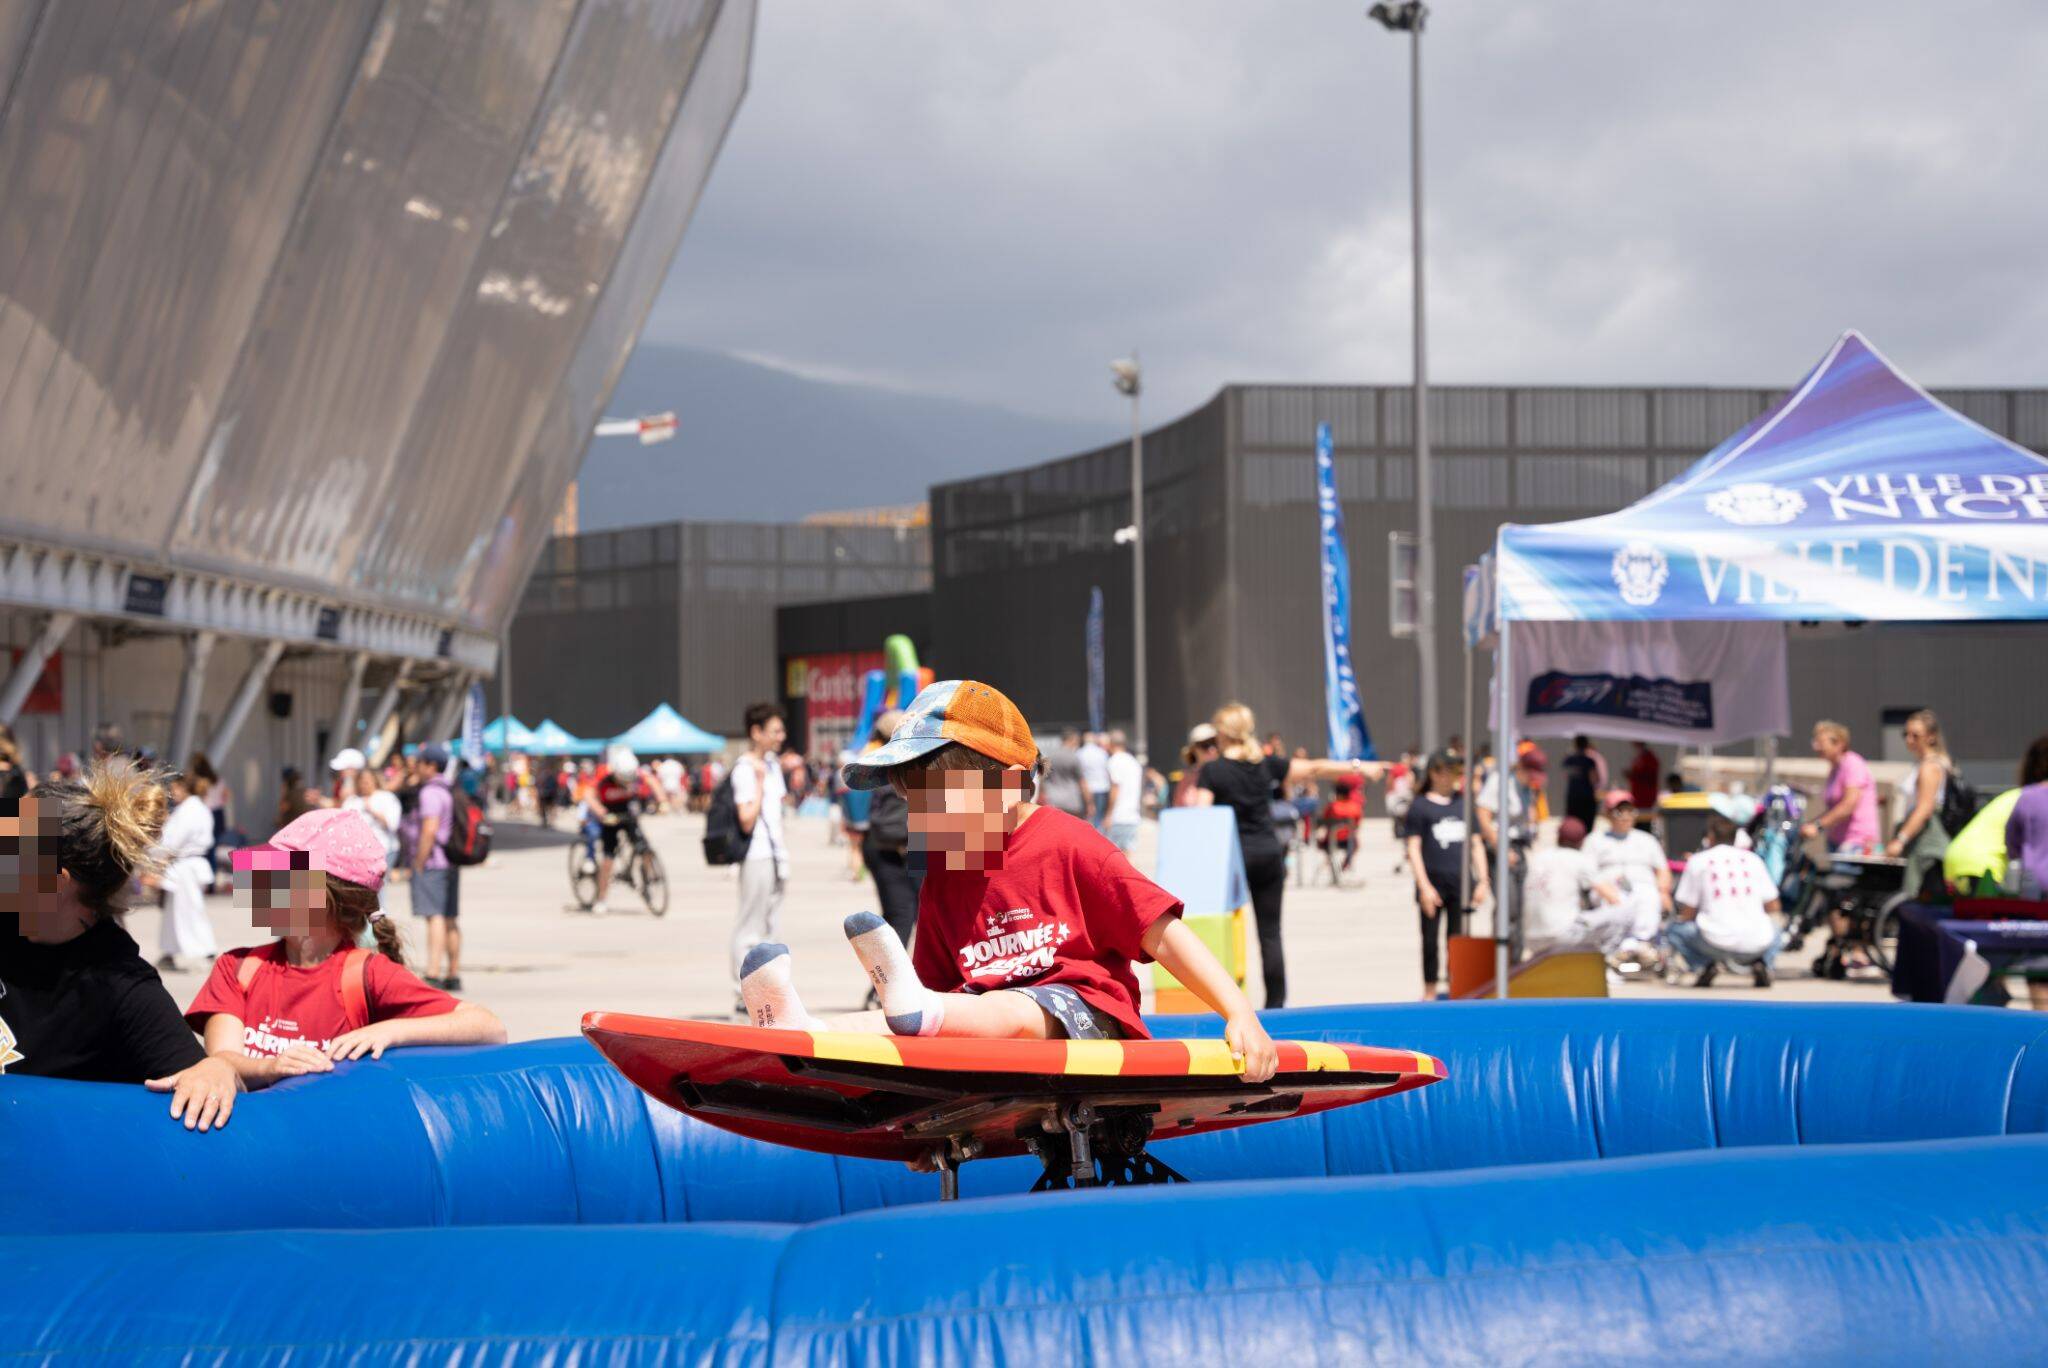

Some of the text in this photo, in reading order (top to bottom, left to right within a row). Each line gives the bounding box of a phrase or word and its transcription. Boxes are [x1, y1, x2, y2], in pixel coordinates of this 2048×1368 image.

[1812, 473, 2048, 497] VILLE DE
[1880, 538, 1968, 601] DE
[1985, 542, 2048, 601] N
[960, 922, 1055, 968] JOURNÉE
